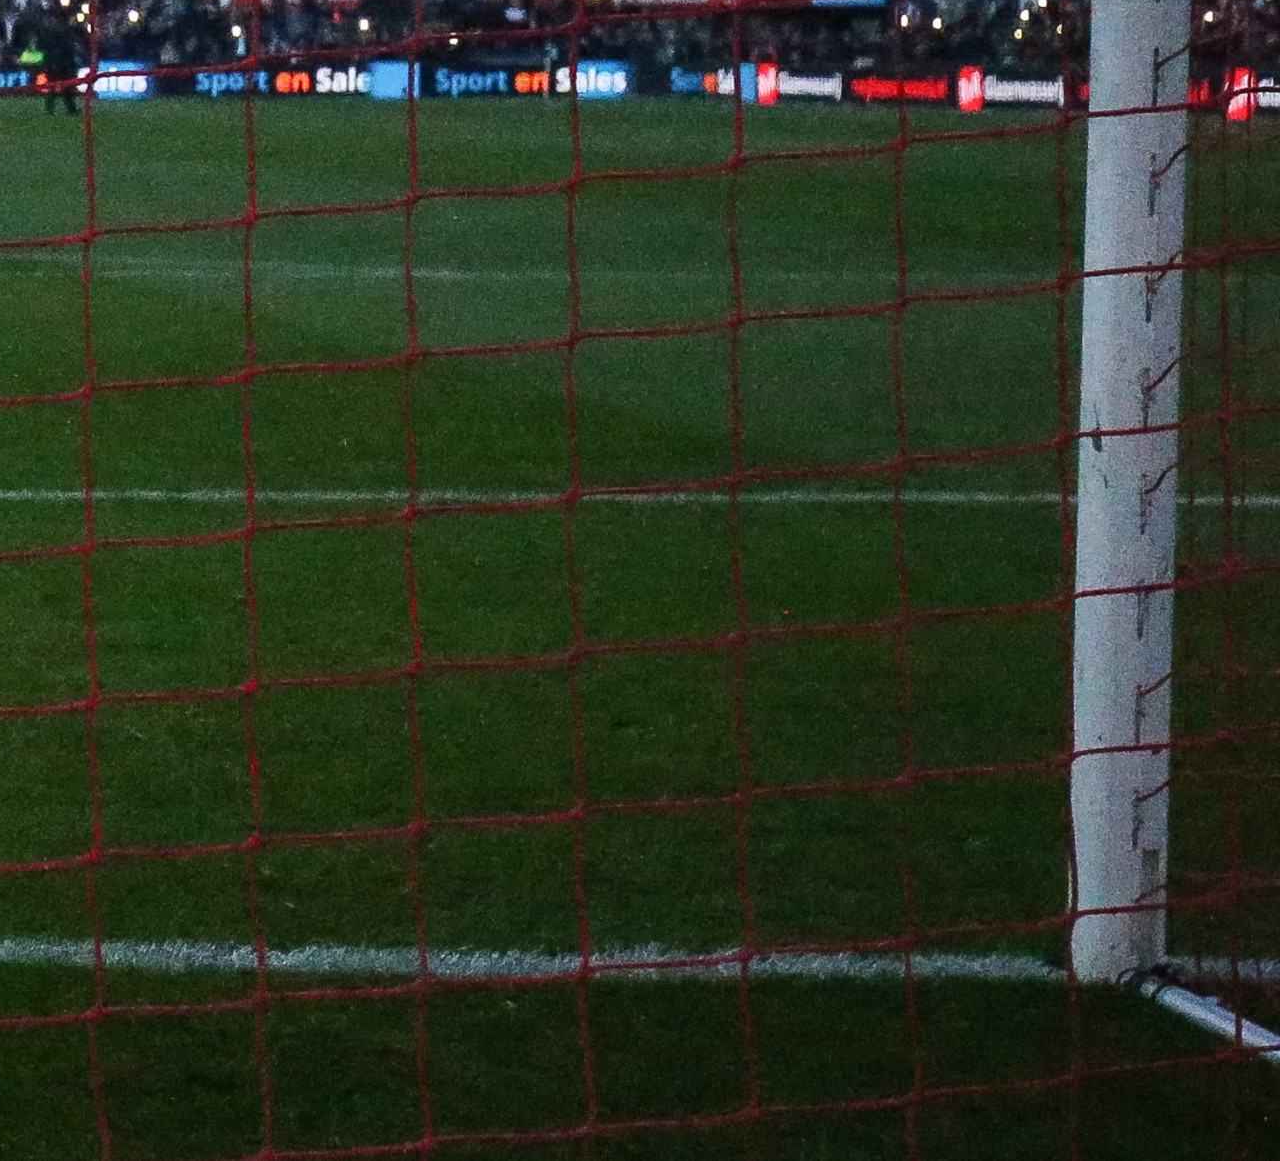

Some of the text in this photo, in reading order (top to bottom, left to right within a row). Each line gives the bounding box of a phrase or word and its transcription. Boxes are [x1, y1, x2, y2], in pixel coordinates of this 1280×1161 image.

[275, 72, 311, 93] en
[436, 68, 508, 98] Sport
[514, 71, 550, 93] en
